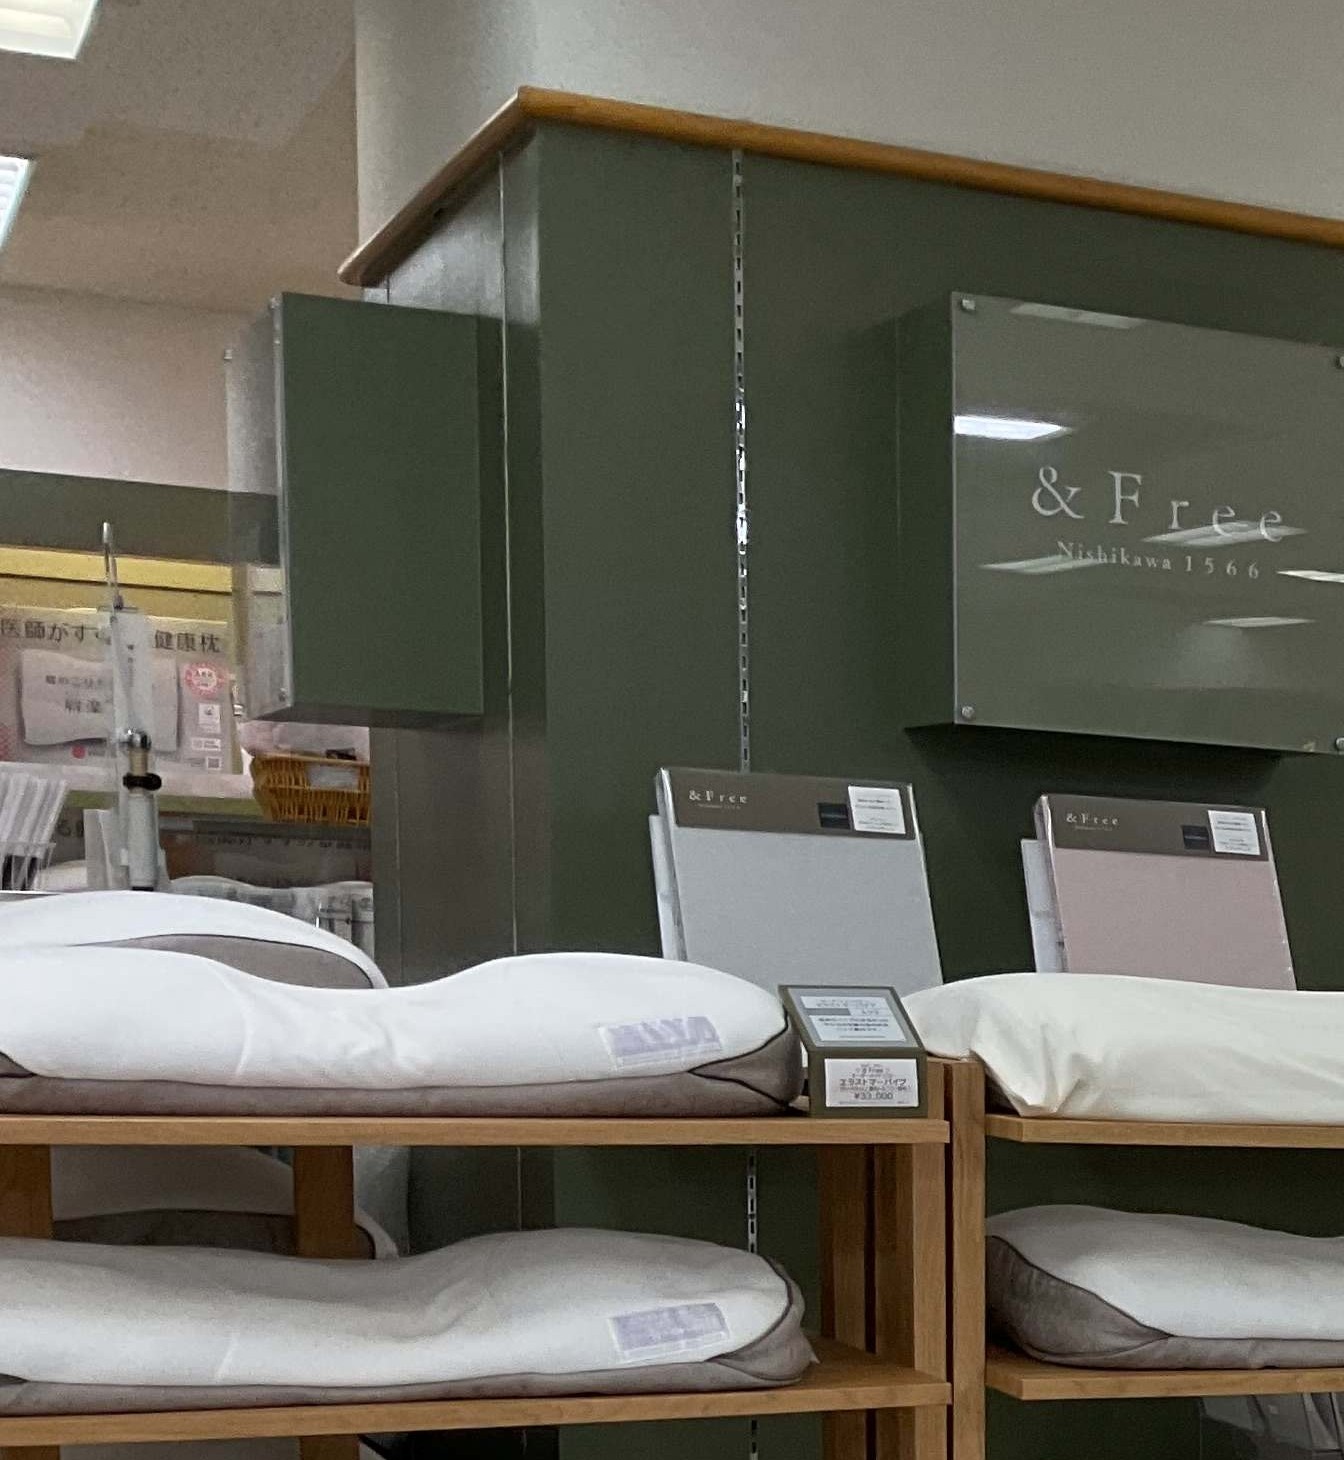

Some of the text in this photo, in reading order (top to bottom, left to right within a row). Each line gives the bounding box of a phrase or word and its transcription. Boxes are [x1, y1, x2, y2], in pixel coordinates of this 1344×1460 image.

[1031, 466, 1282, 542] & Free
[1057, 540, 1259, 580] Nishikawa 1566
